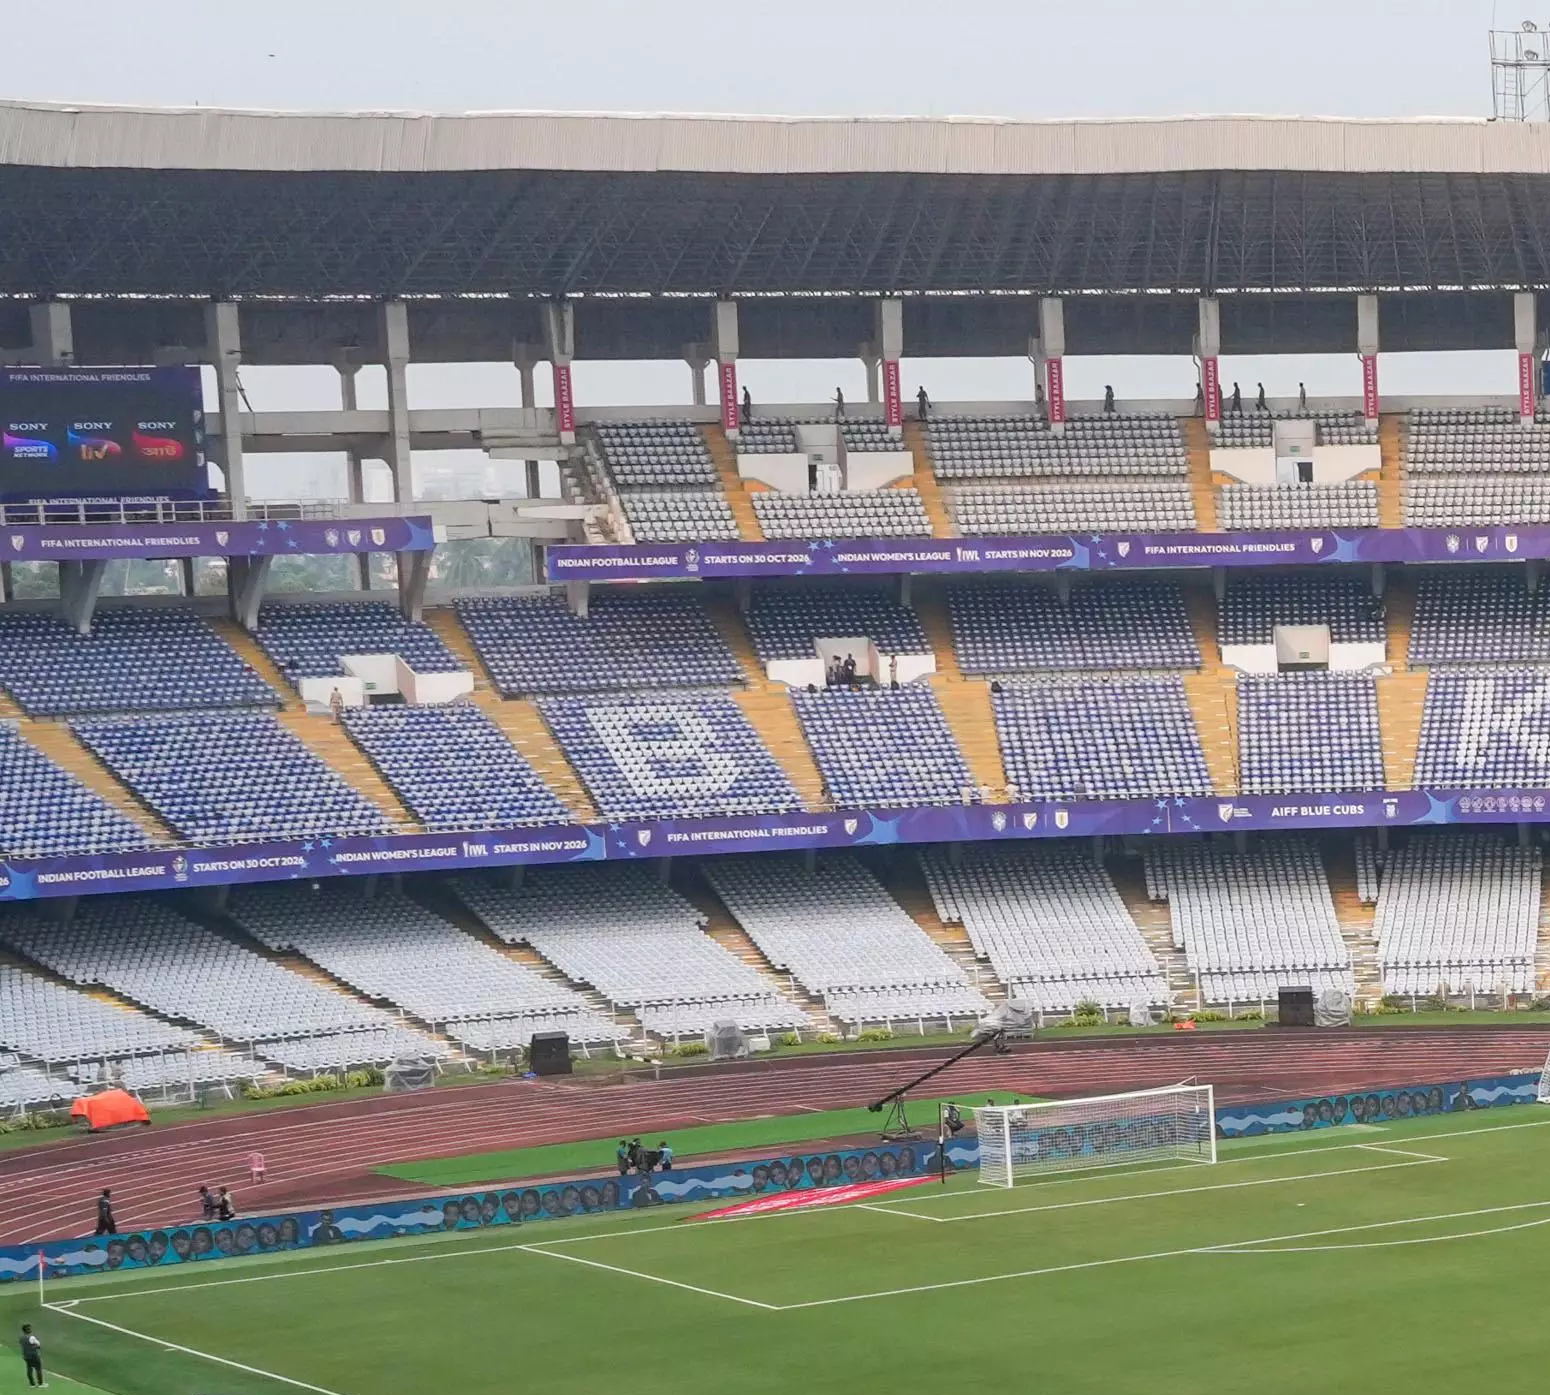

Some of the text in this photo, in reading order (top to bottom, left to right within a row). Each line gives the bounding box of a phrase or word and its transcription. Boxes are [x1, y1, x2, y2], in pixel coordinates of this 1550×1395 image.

[40, 536, 200, 547] FIFA INTERNATIONAL FRIENDLIES
[984, 548, 1072, 559] STARTS IN NOV 2026
[1145, 543, 1295, 554] FIFA INTERNATIONAL FRIENDLIES
[557, 556, 677, 567] INDIAN FOOTBALL LEAGUE
[704, 554, 811, 564] STARTS ON 30 OCT 2026
[837, 552, 950, 562] INDIAN WOMEN'S LEAGUE
[962, 550, 980, 561] IWL
[584, 706, 741, 796] B
[1271, 804, 1364, 816] AIFF BLUE CUBS
[667, 825, 827, 842] FIFA INTERNATIONAL FRIENDLIES
[468, 844, 488, 856] IWL
[493, 840, 586, 853] STARTS IN NOV 2026
[335, 847, 456, 862] INDIAN WOMEN'S LEAGUE
[193, 855, 304, 872] STARTS ON 30 OCT 2026
[38, 872, 73, 883] INDIAN
[73, 868, 125, 881] FOOTBALL
[126, 865, 165, 877] LEAGUE
